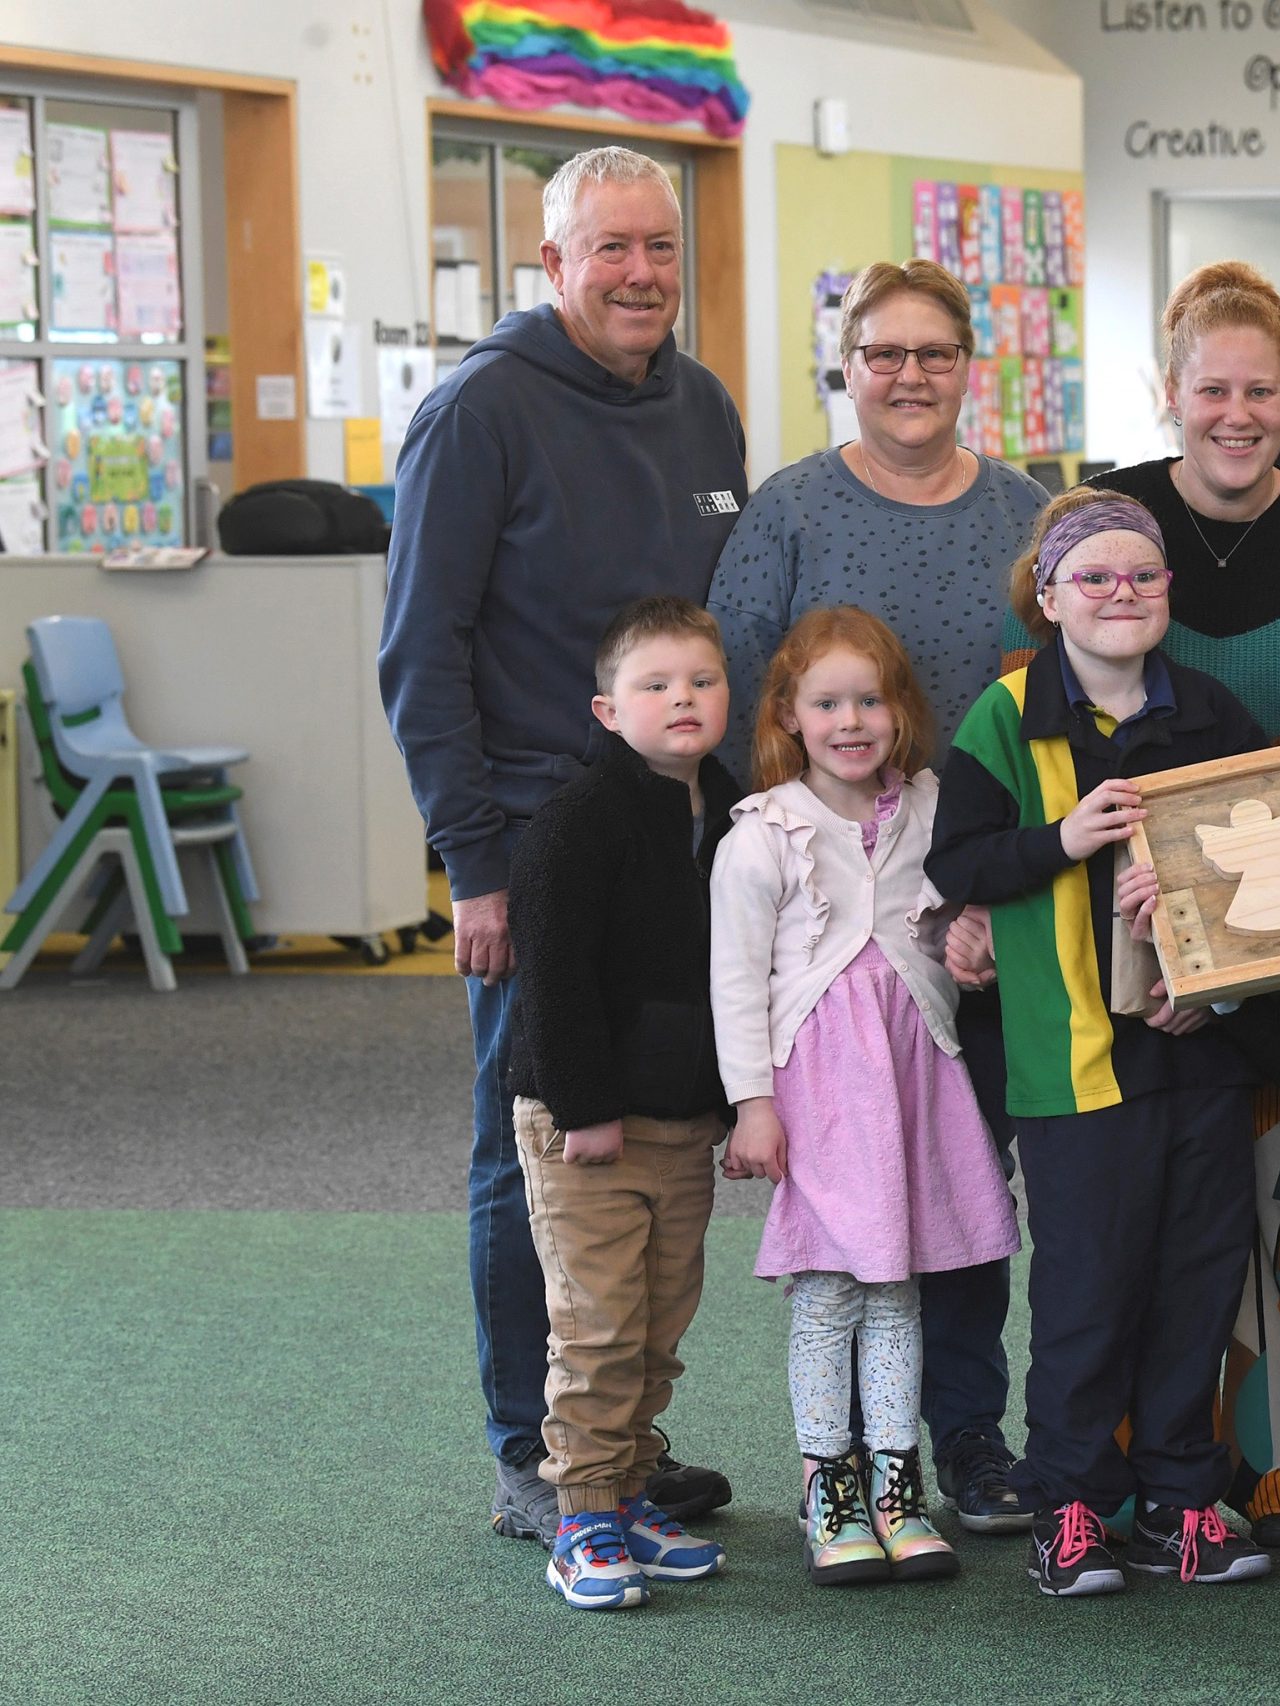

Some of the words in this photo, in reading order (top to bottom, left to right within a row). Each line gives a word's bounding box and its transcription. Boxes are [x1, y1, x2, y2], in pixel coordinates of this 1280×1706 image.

[1100, 0, 1206, 32] Listen
[1219, 0, 1254, 30] to
[1123, 119, 1266, 158] Creative
[570, 1521, 612, 1542] SPIDER-MAN
